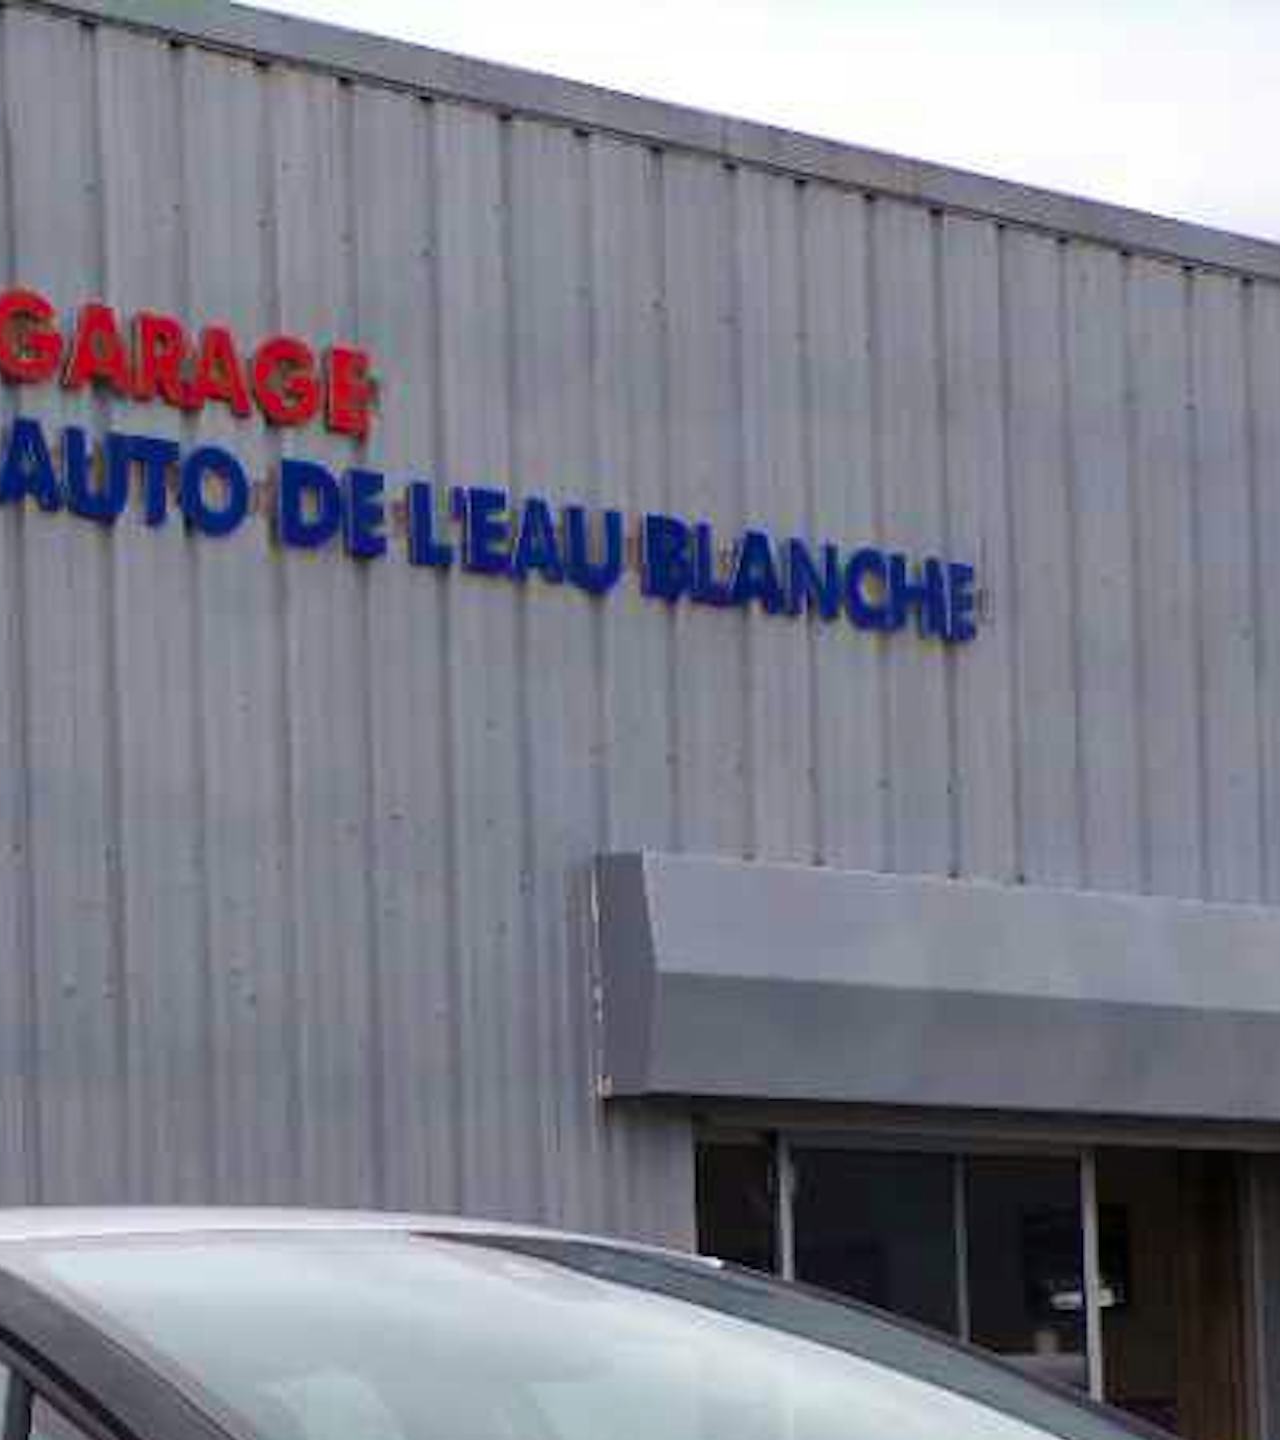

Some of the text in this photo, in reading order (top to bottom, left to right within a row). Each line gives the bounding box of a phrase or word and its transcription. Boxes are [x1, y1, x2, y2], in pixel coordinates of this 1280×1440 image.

[277, 457, 388, 558] DE
[406, 480, 621, 594] L'EAU
[640, 512, 976, 644] BLANCHE
